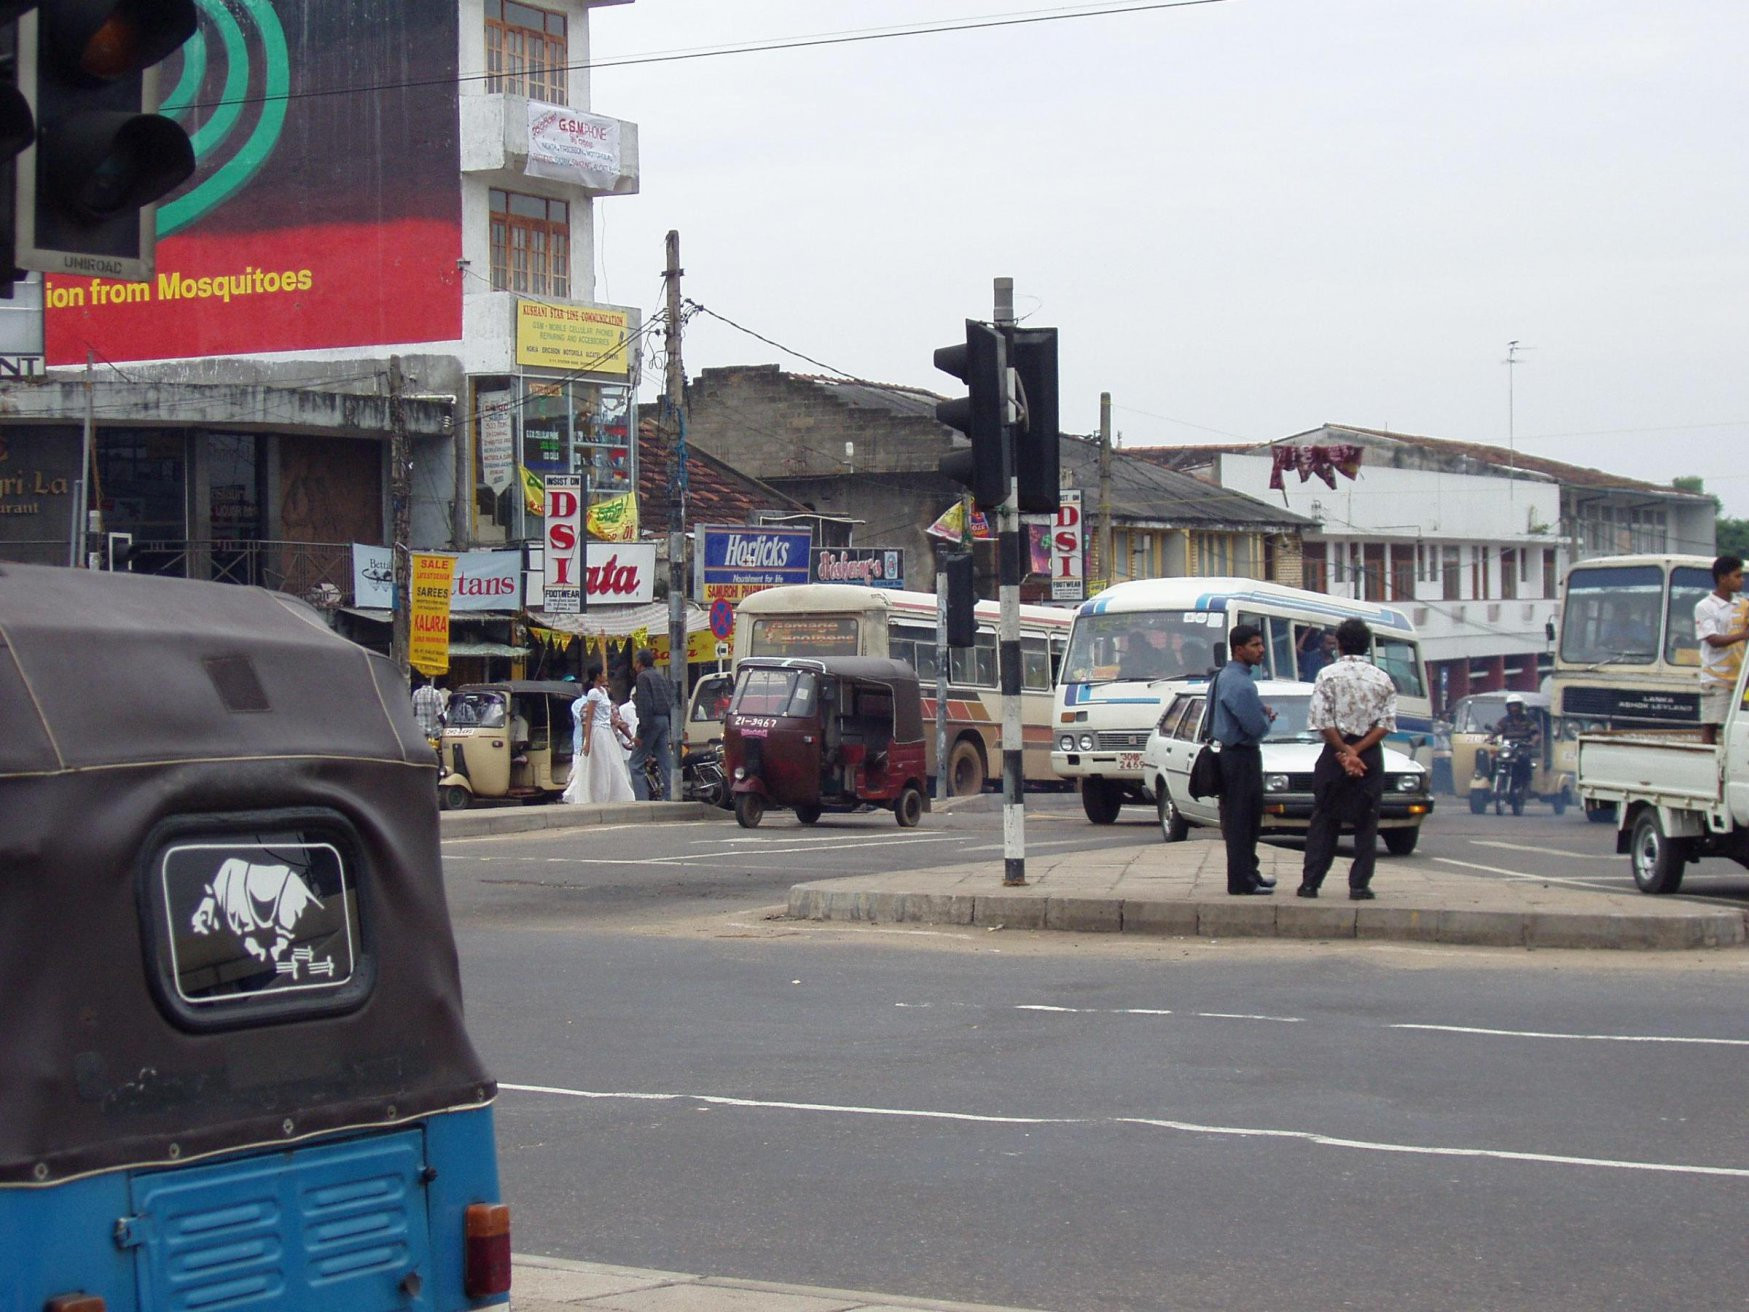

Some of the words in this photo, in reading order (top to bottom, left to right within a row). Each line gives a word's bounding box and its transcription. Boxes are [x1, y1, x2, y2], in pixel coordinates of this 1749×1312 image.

[64, 256, 122, 273] UNIROAD
[47, 282, 84, 308] ion
[90, 279, 150, 304] from
[158, 267, 312, 302] Mosquitoes
[547, 491, 578, 585] DSI
[724, 534, 789, 567] Horlicks
[421, 560, 449, 569] SALE
[458, 570, 515, 596] tans
[417, 587, 449, 598] SAREES
[546, 590, 580, 598] FOOTWEAR
[735, 716, 777, 728] 21-3967
